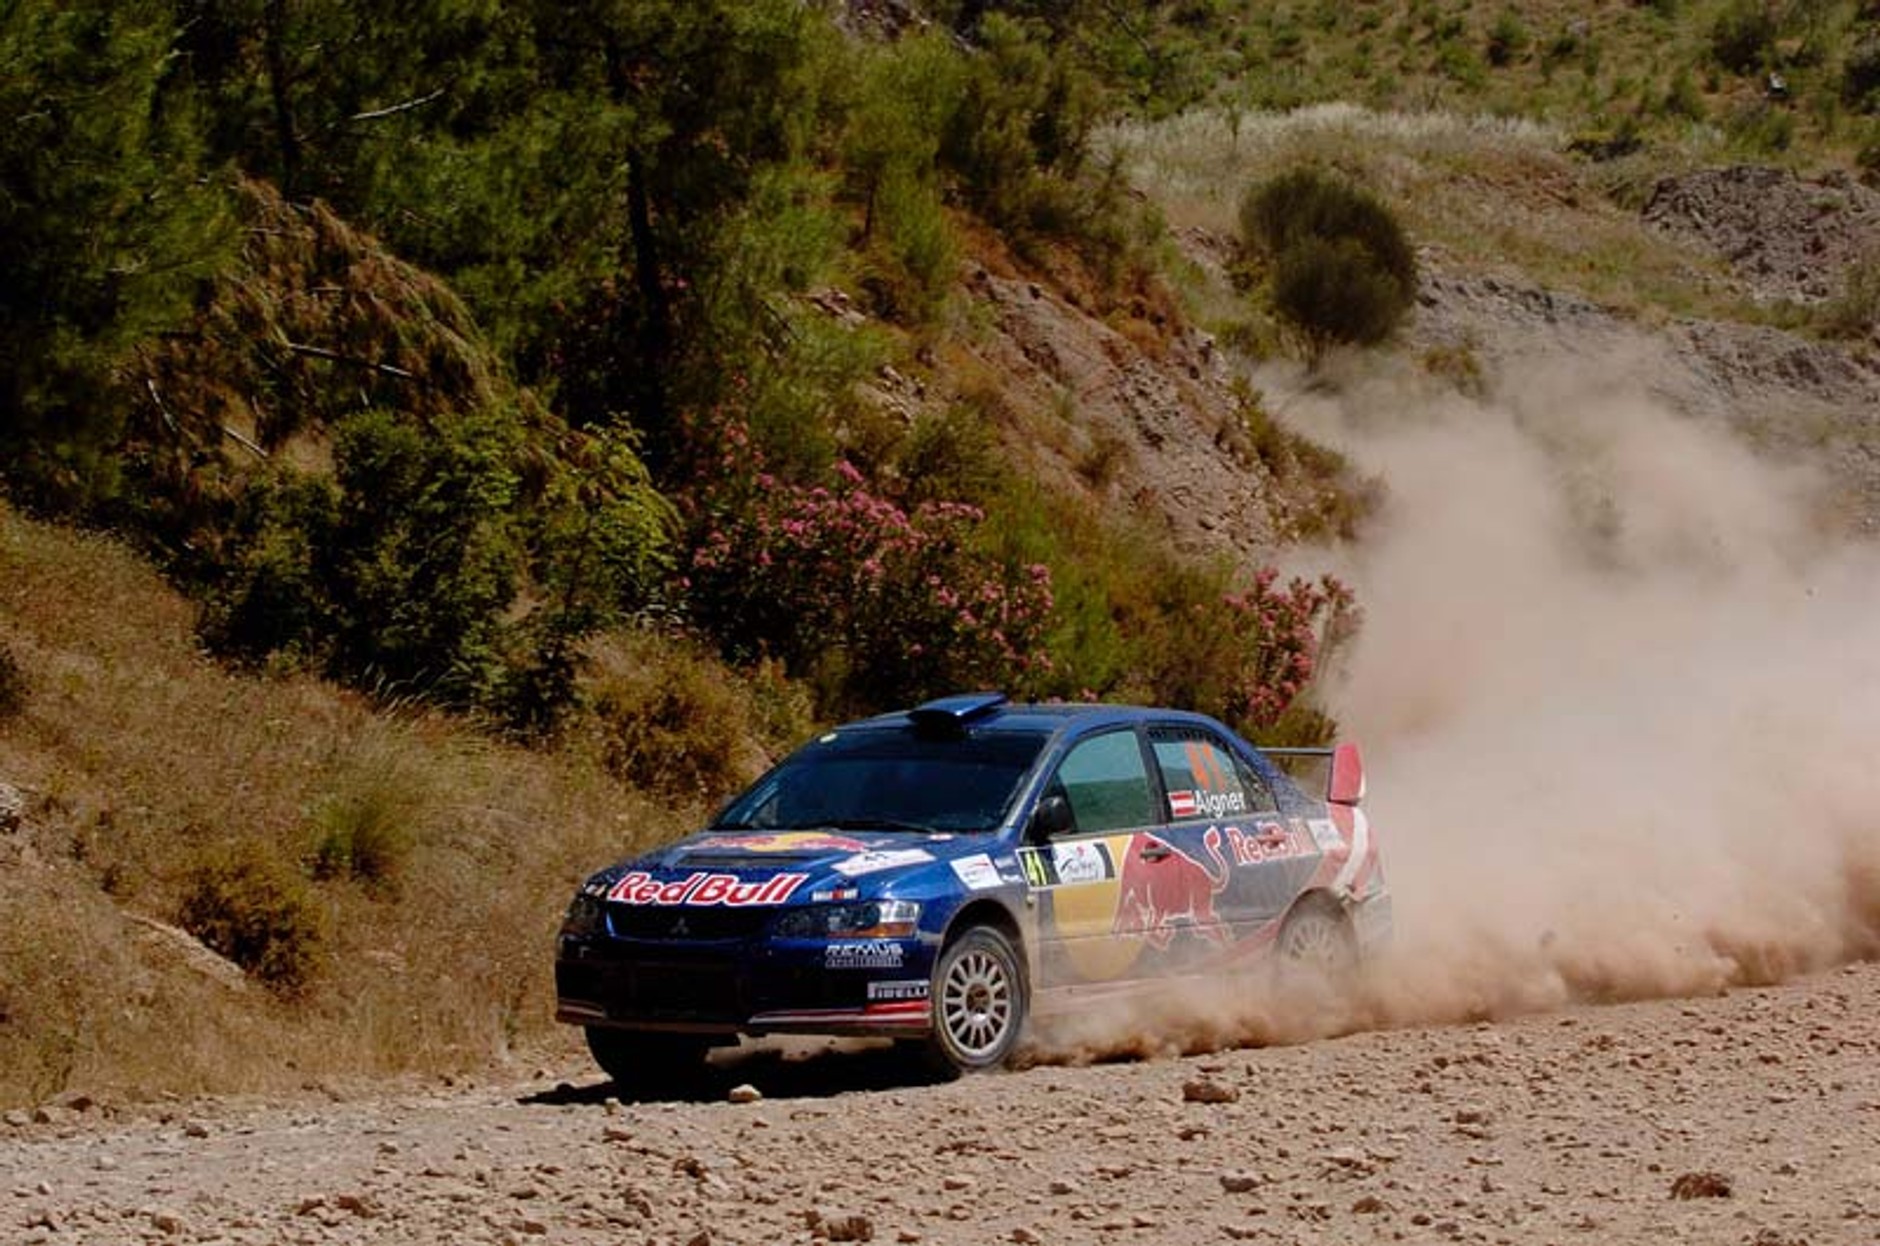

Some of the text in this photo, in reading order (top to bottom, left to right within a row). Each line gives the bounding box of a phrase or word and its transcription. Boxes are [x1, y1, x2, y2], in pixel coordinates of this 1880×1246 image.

[1194, 790, 1245, 818] Aigner
[607, 872, 810, 906] Red Bull
[825, 943, 903, 956] REMUS
[867, 979, 929, 998] PIRELLI
